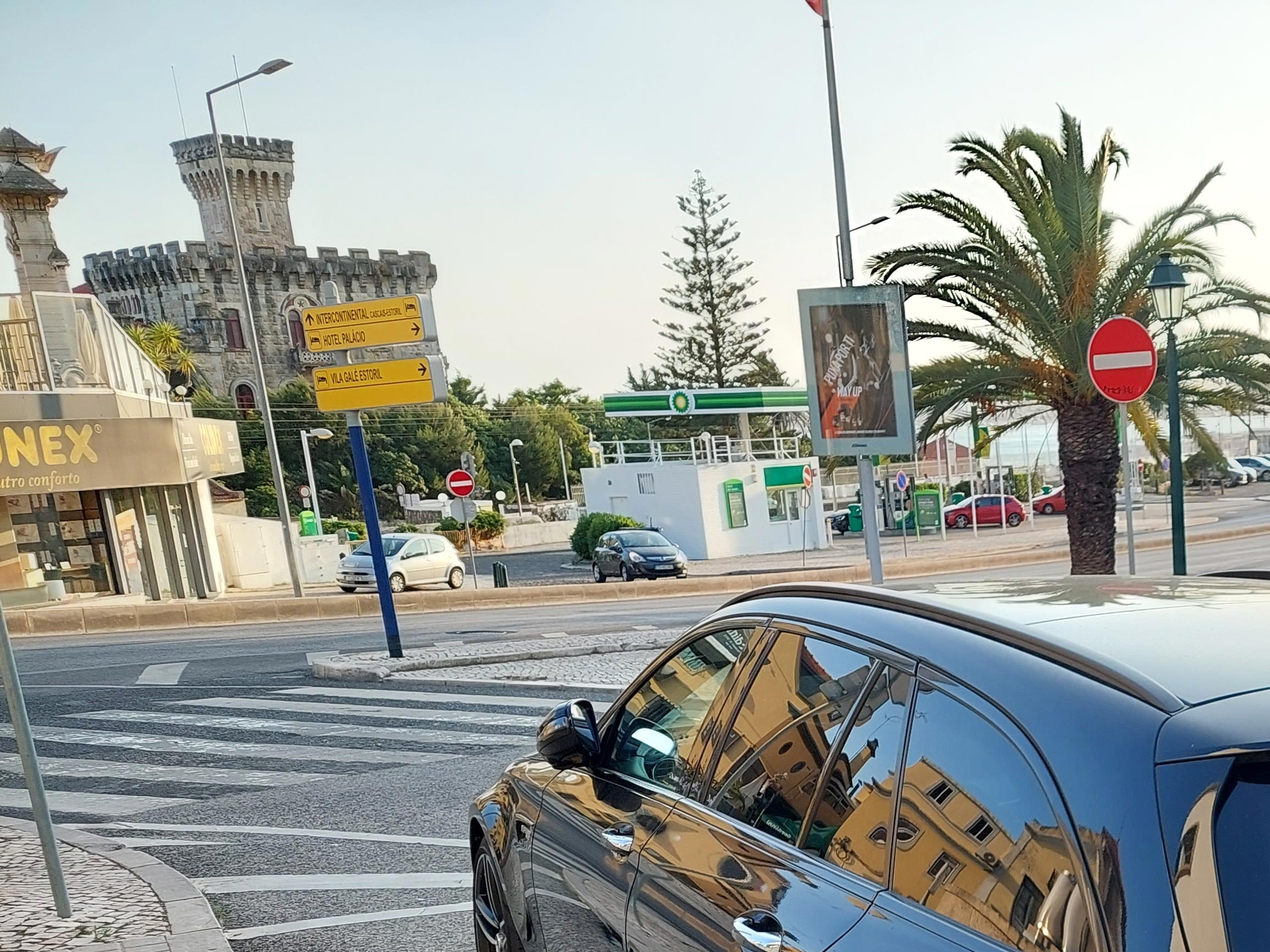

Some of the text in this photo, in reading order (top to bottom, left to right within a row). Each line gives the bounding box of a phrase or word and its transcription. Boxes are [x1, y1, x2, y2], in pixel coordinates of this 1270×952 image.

[315, 307, 402, 325] INTERCONTINENTAL CASCAIS-ESTORIL
[322, 329, 366, 346] HOTEL PALÁCIO
[834, 342, 852, 361] POR
[330, 368, 383, 384] VILA GALÉ ESTORIL
[837, 386, 863, 397] WAY UP
[0, 424, 98, 467] NEX
[28, 470, 80, 492] conforto
